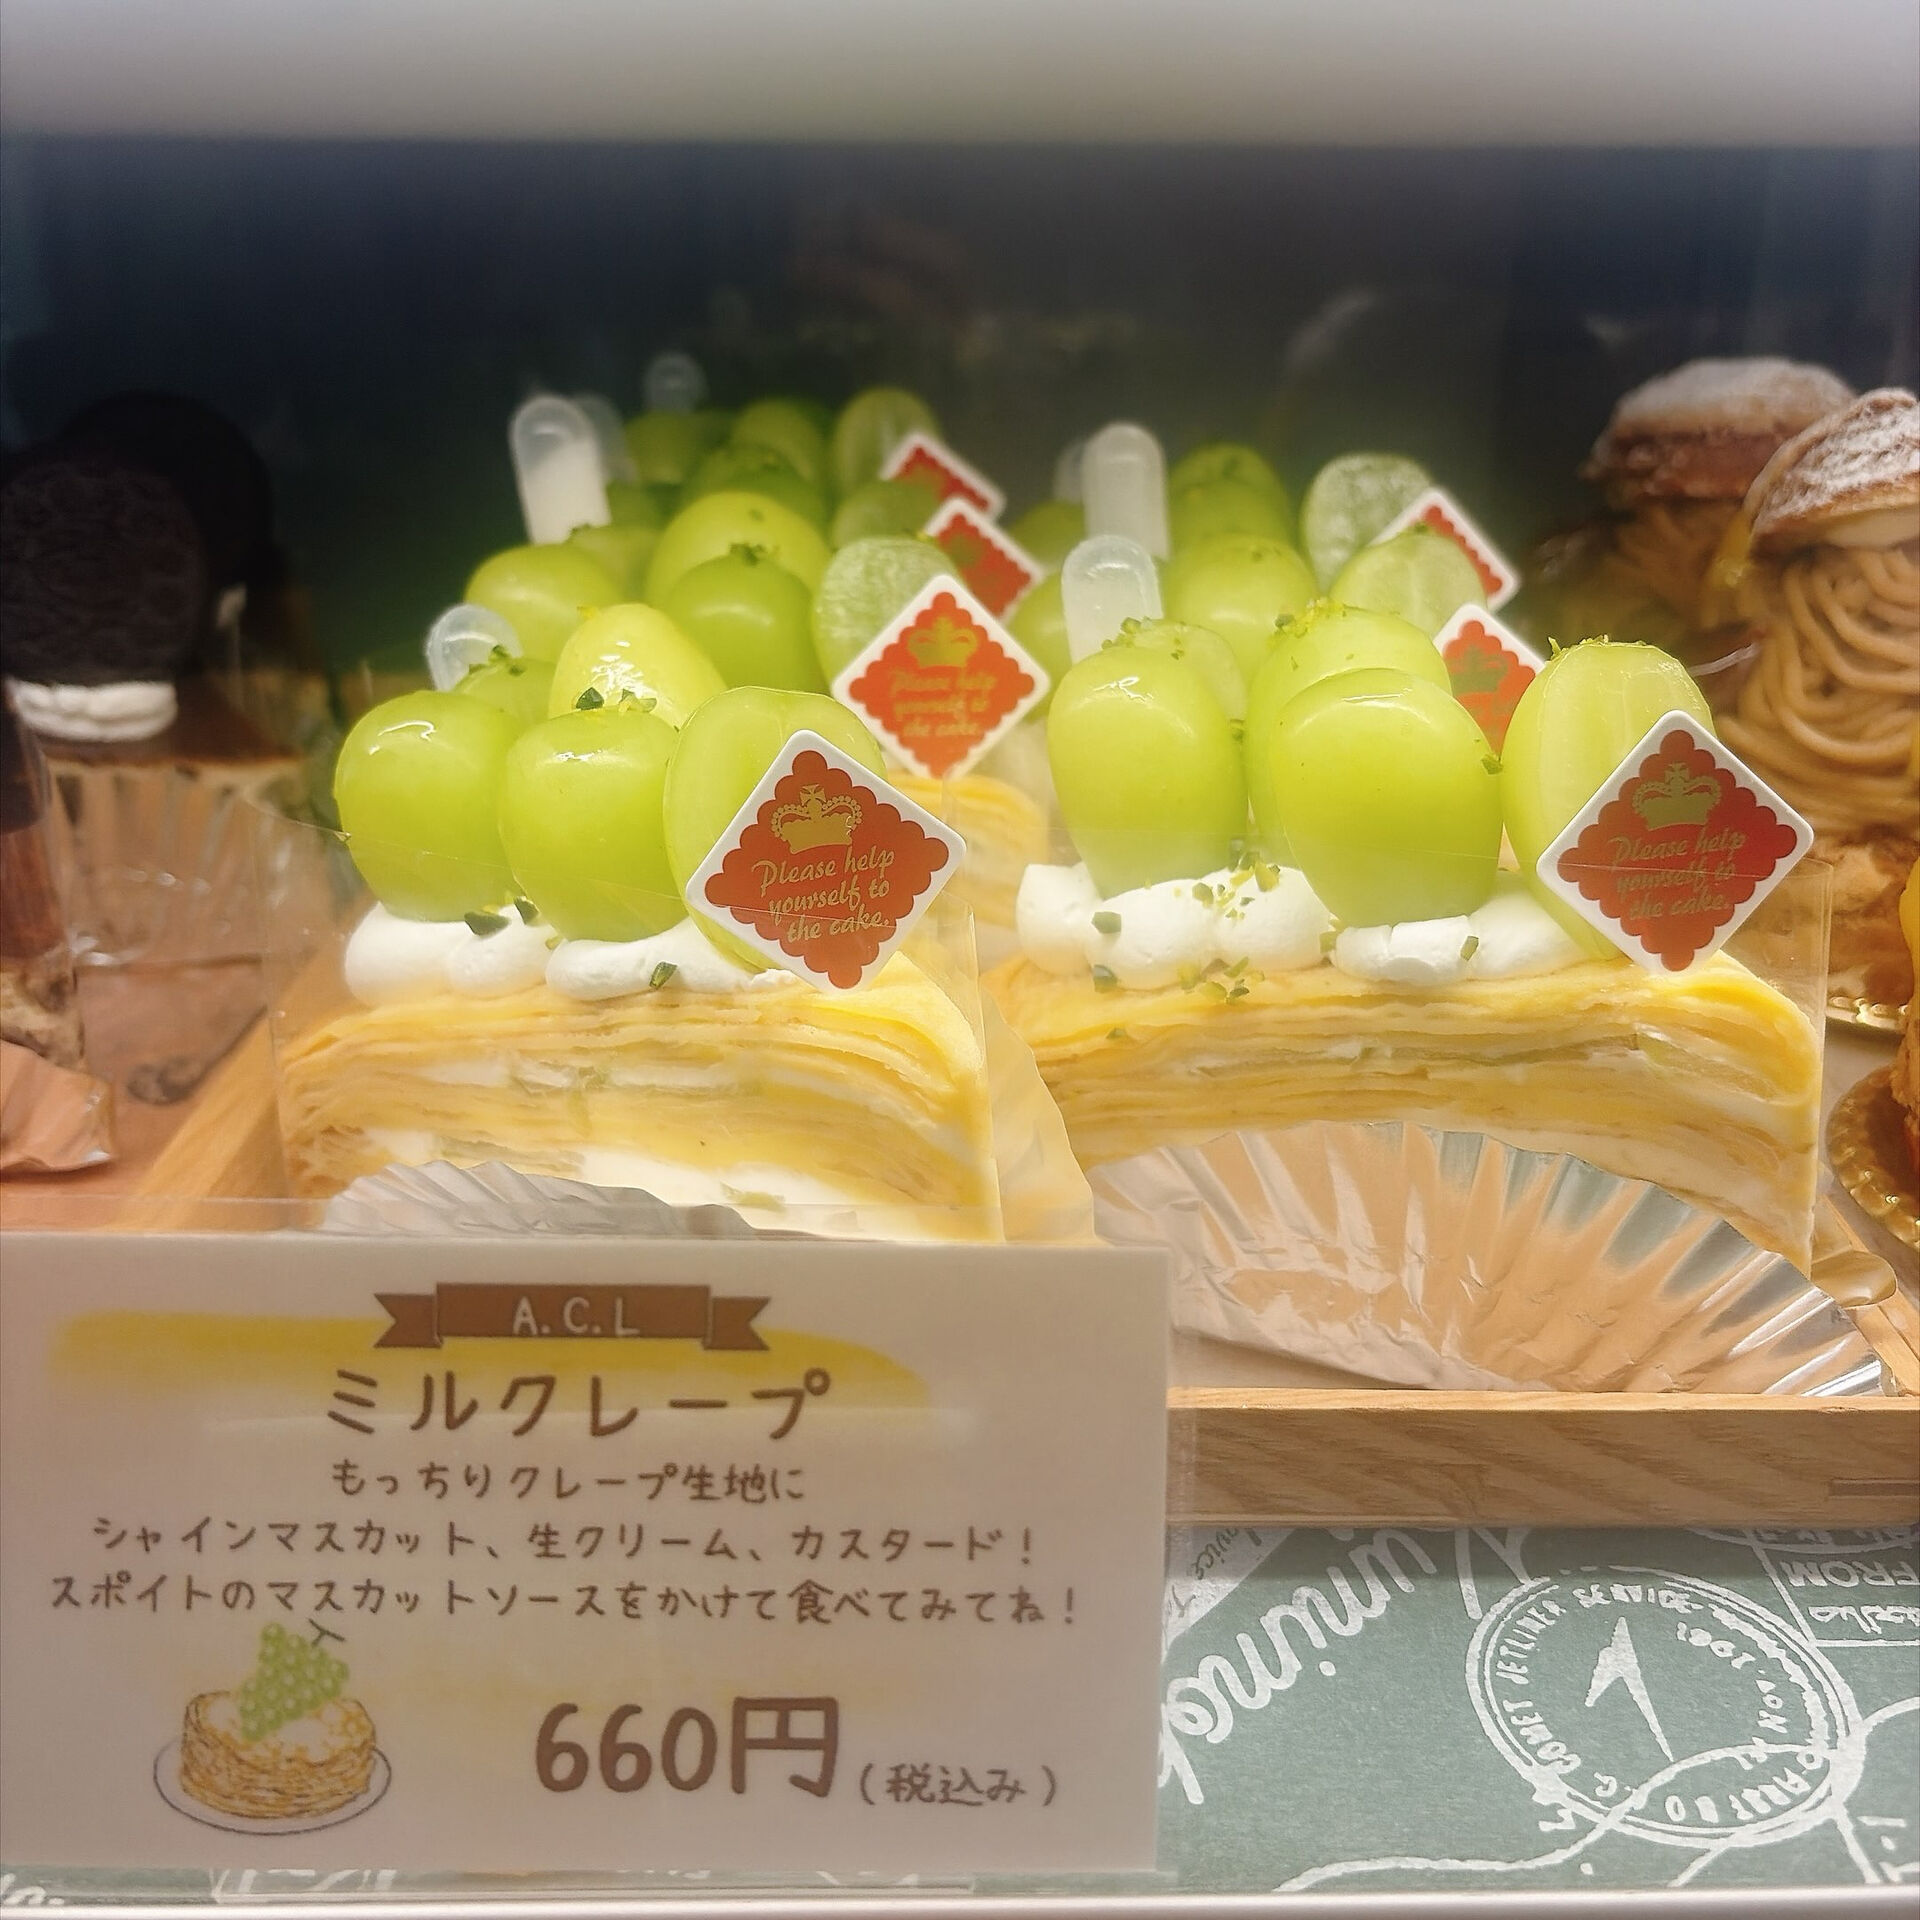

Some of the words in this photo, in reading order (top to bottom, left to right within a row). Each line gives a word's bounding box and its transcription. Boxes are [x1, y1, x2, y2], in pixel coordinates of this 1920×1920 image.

[751, 859, 836, 896] Please
[845, 846, 895, 879] help
[1607, 835, 1687, 871] Please
[1694, 827, 1746, 859] help
[768, 876, 860, 924] yourself
[869, 880, 890, 898] to
[1617, 856, 1706, 901] yourself
[787, 915, 821, 943] the
[830, 904, 890, 936] cake.
[1629, 893, 1662, 920] the
[512, 1296, 640, 1336] A.C.L
[327, 1367, 831, 1440] ミルクレープ
[333, 1458, 805, 1503] もっちりクレープ生地に
[93, 1516, 1033, 1566] シャインマスカット、生クリーム、カスタード！
[1779, 1561, 1920, 1588] FROM
[51, 1570, 1076, 1625] スポイトのマスカットソースをかけて食べてみてね！
[535, 1696, 839, 1798] 660円
